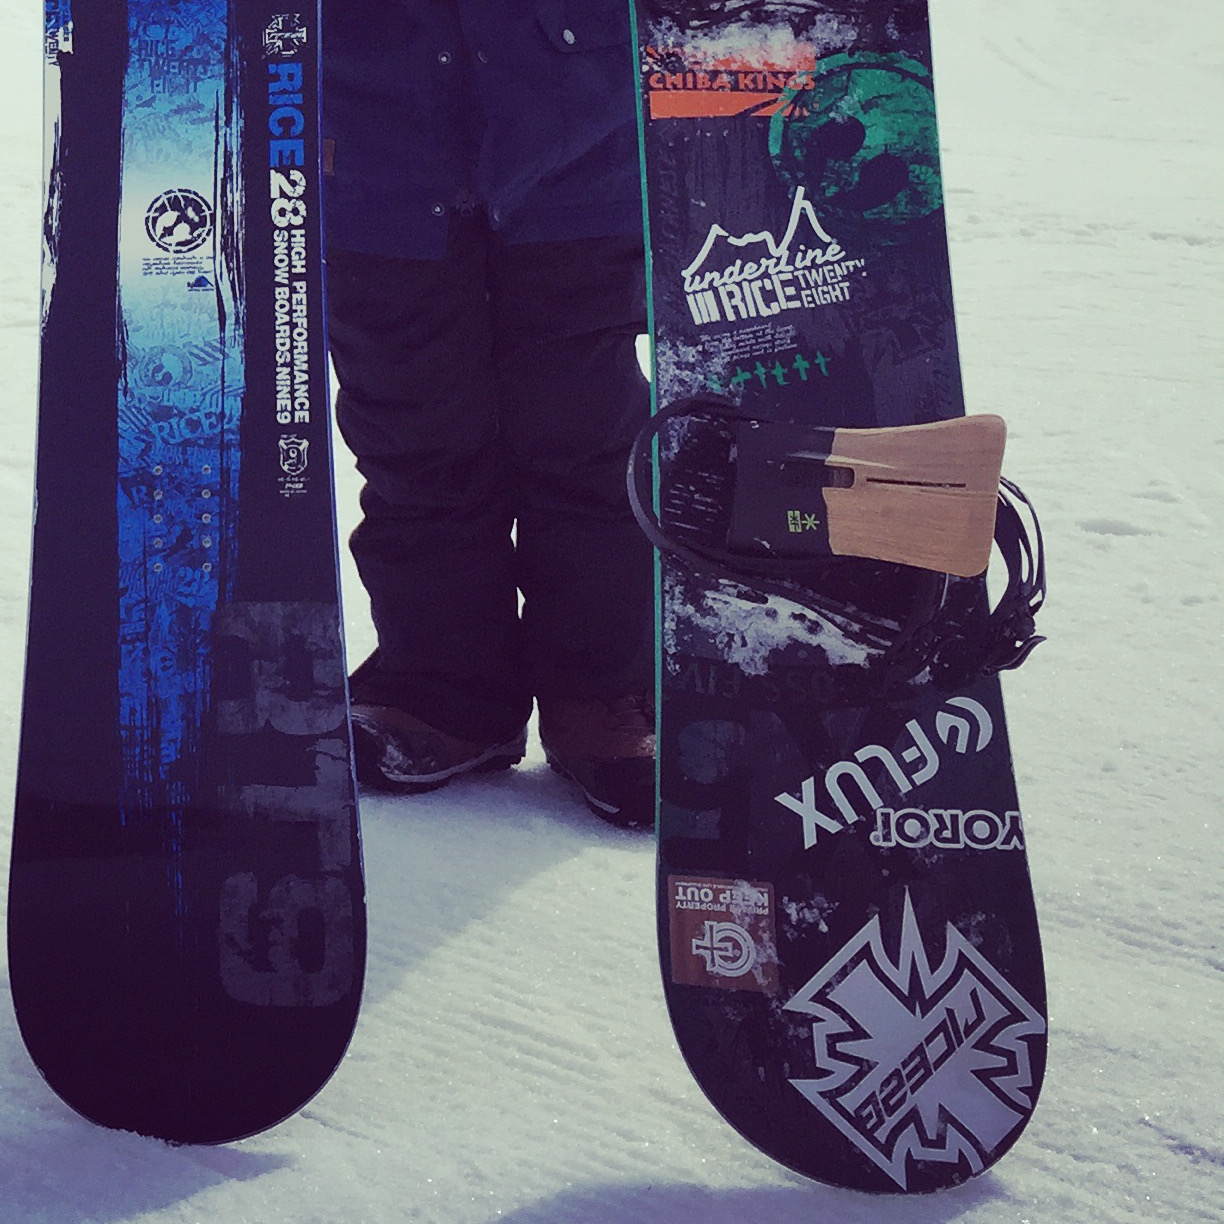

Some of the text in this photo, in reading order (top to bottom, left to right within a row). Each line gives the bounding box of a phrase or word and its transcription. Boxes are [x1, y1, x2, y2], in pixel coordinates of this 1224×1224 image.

[649, 72, 816, 90] CHIBA KINGS
[273, 229, 290, 284] SNOW
[717, 273, 802, 322] RICE
[801, 281, 851, 308] EIGHT
[290, 229, 310, 424] HIGH PERFORMANCE
[774, 718, 940, 851] FLUX
[872, 807, 1026, 851] YOROI
[675, 886, 714, 902] OUT
[675, 901, 727, 912] PROPERTY
